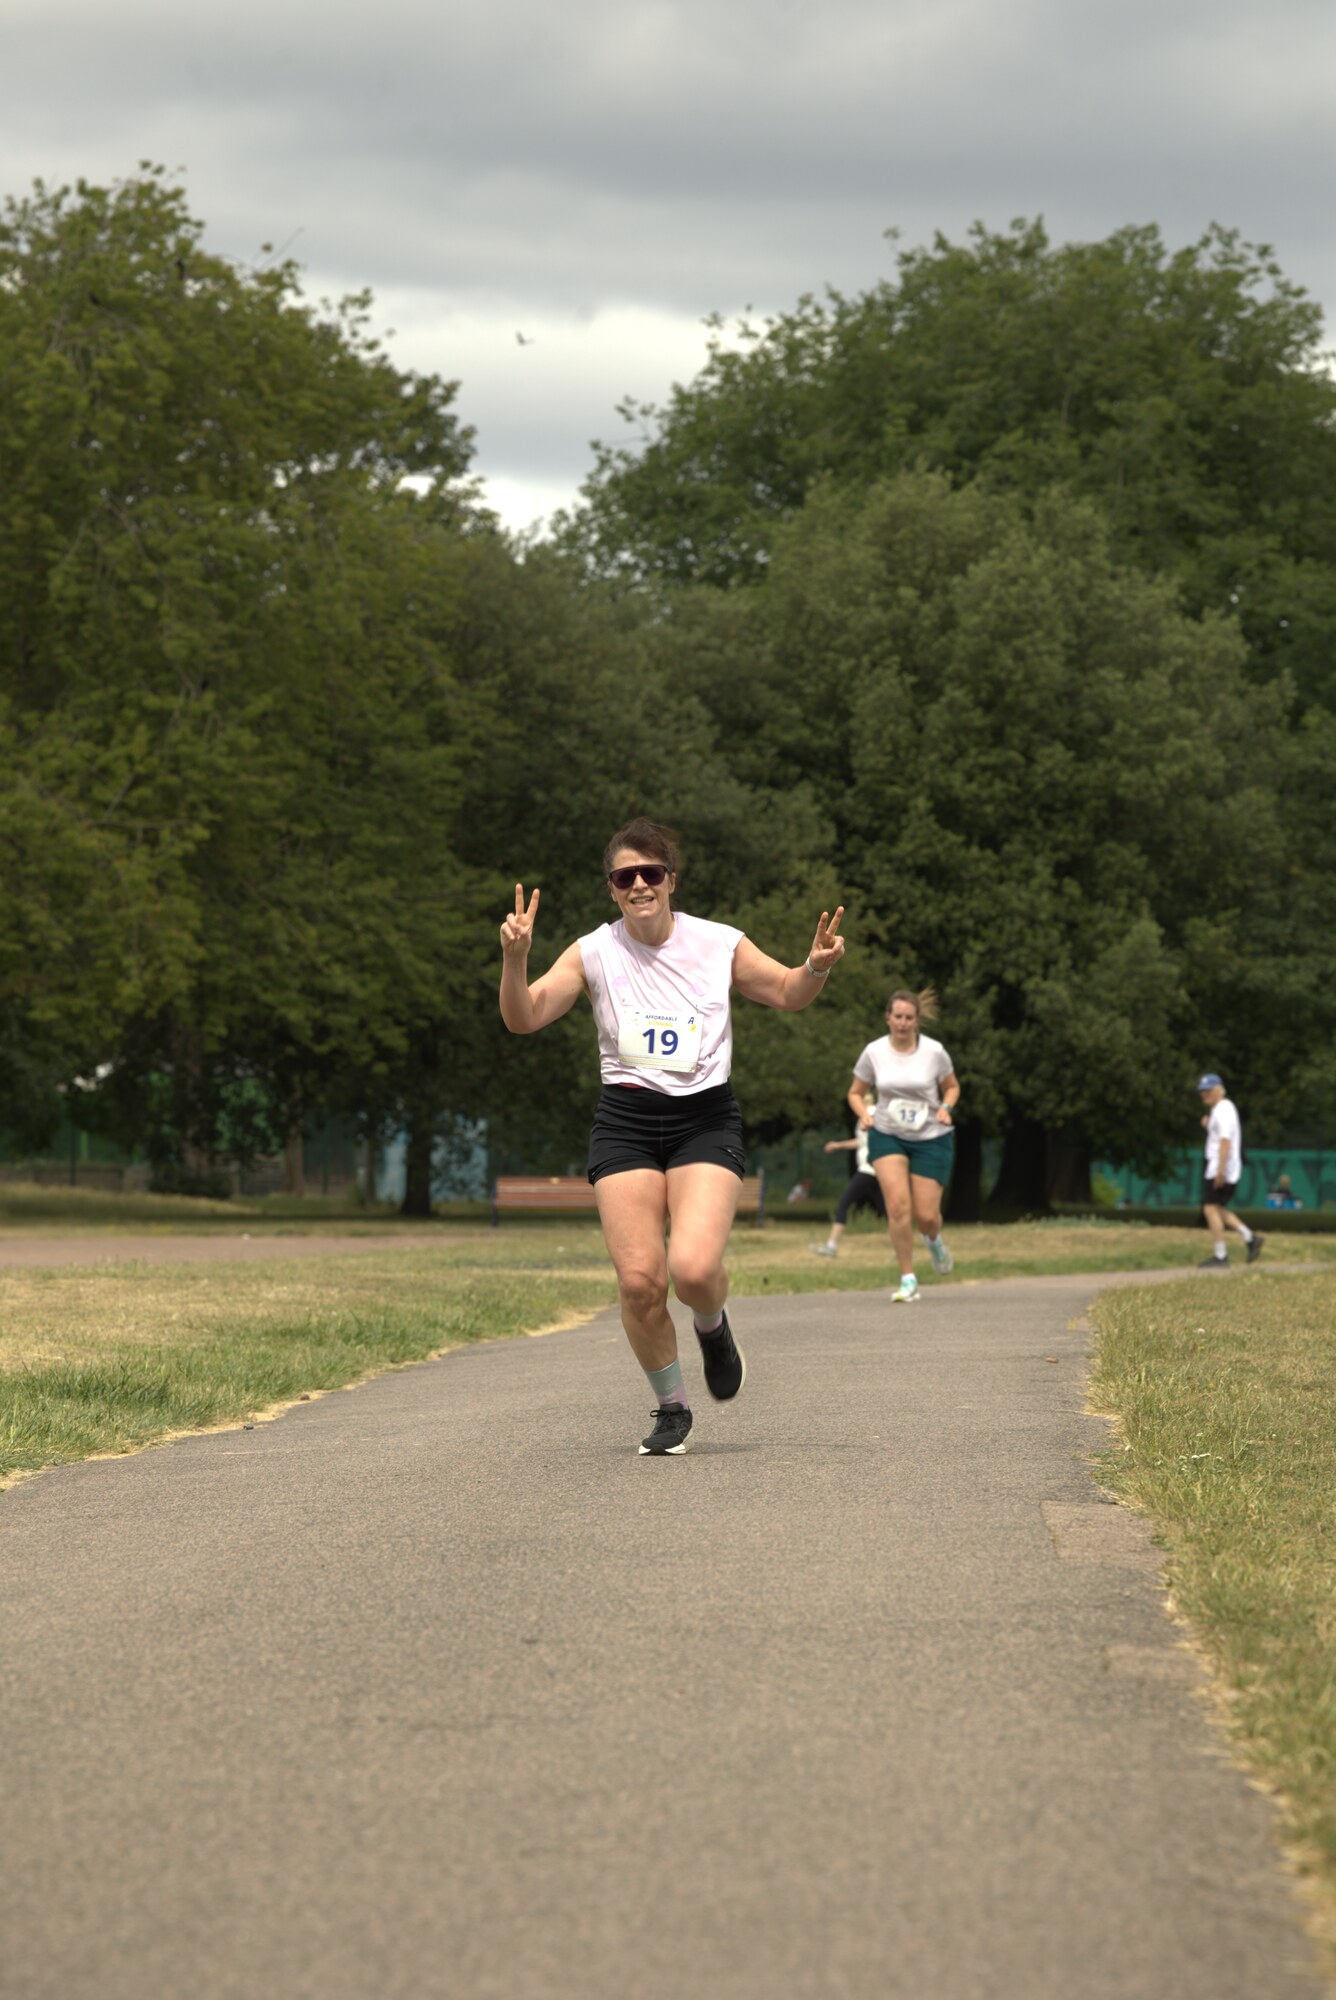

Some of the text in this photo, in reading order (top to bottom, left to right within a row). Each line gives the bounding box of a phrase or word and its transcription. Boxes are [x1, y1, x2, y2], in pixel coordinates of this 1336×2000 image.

[687, 1016, 695, 1025] A
[642, 1028, 679, 1055] 19
[899, 1109, 916, 1123] 13
